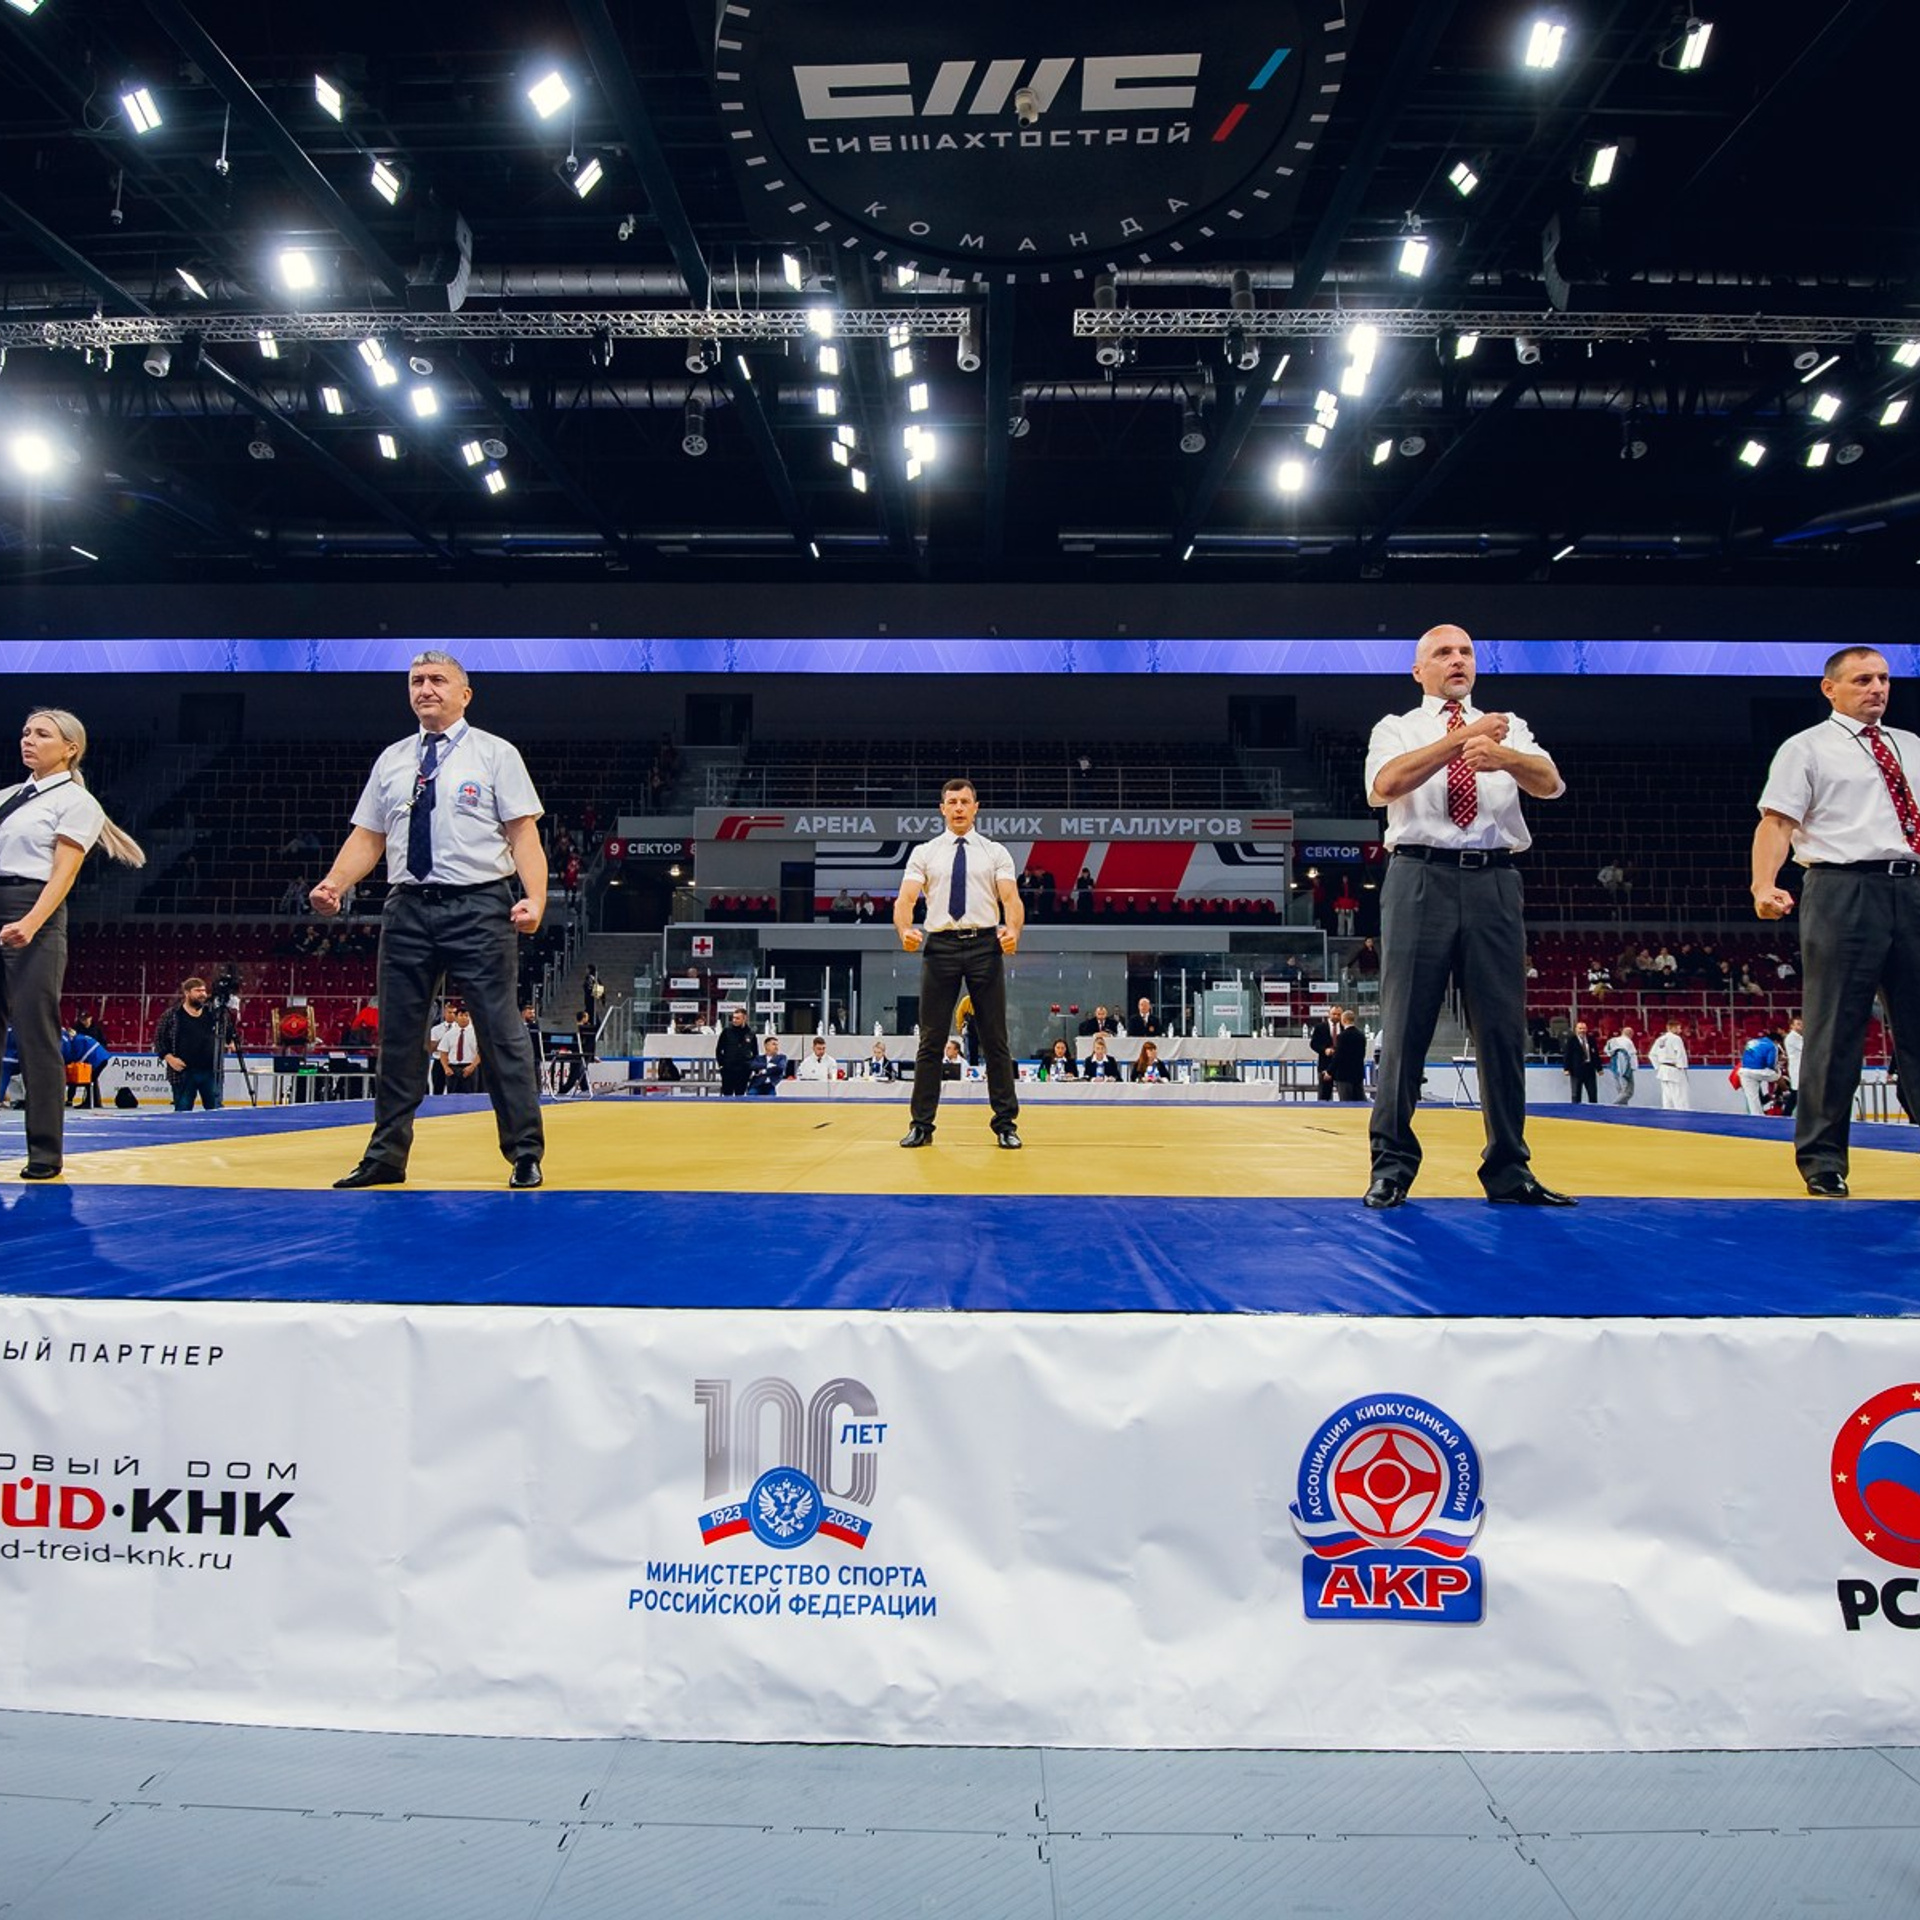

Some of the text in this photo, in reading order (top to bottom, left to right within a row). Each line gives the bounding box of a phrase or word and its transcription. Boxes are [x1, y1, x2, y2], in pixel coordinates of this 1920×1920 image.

[807, 122, 1192, 154] СИБШАХТОСТРОЙ
[864, 197, 1189, 253] КОМАНДА
[794, 815, 1242, 837] АРЕНА КУЗЦКИХ МЕТАЛЛУРГОВ
[610, 842, 620, 856] 9
[627, 842, 682, 855] СЕКТОР
[1305, 846, 1360, 858] СЕКТОР
[1368, 846, 1379, 859] 7
[111, 1057, 152, 1069] Арена
[124, 1071, 169, 1081] Метал
[68, 1342, 225, 1366] ПАРТНЕР
[840, 1423, 888, 1445] ЛЕТ
[1307, 1402, 1471, 1517] АССОЦИАЦИЯ КИОКУСИНКАЙ РОССИИ
[708, 1504, 743, 1527] 1923
[826, 1509, 863, 1533] 2023
[645, 1561, 928, 1587] МИНИСТЕРСТВО СПОРТА
[1318, 1563, 1472, 1612] АКР
[628, 1587, 938, 1619] РОССИЙСКОЙ ФЕДЕРАЦИИ
